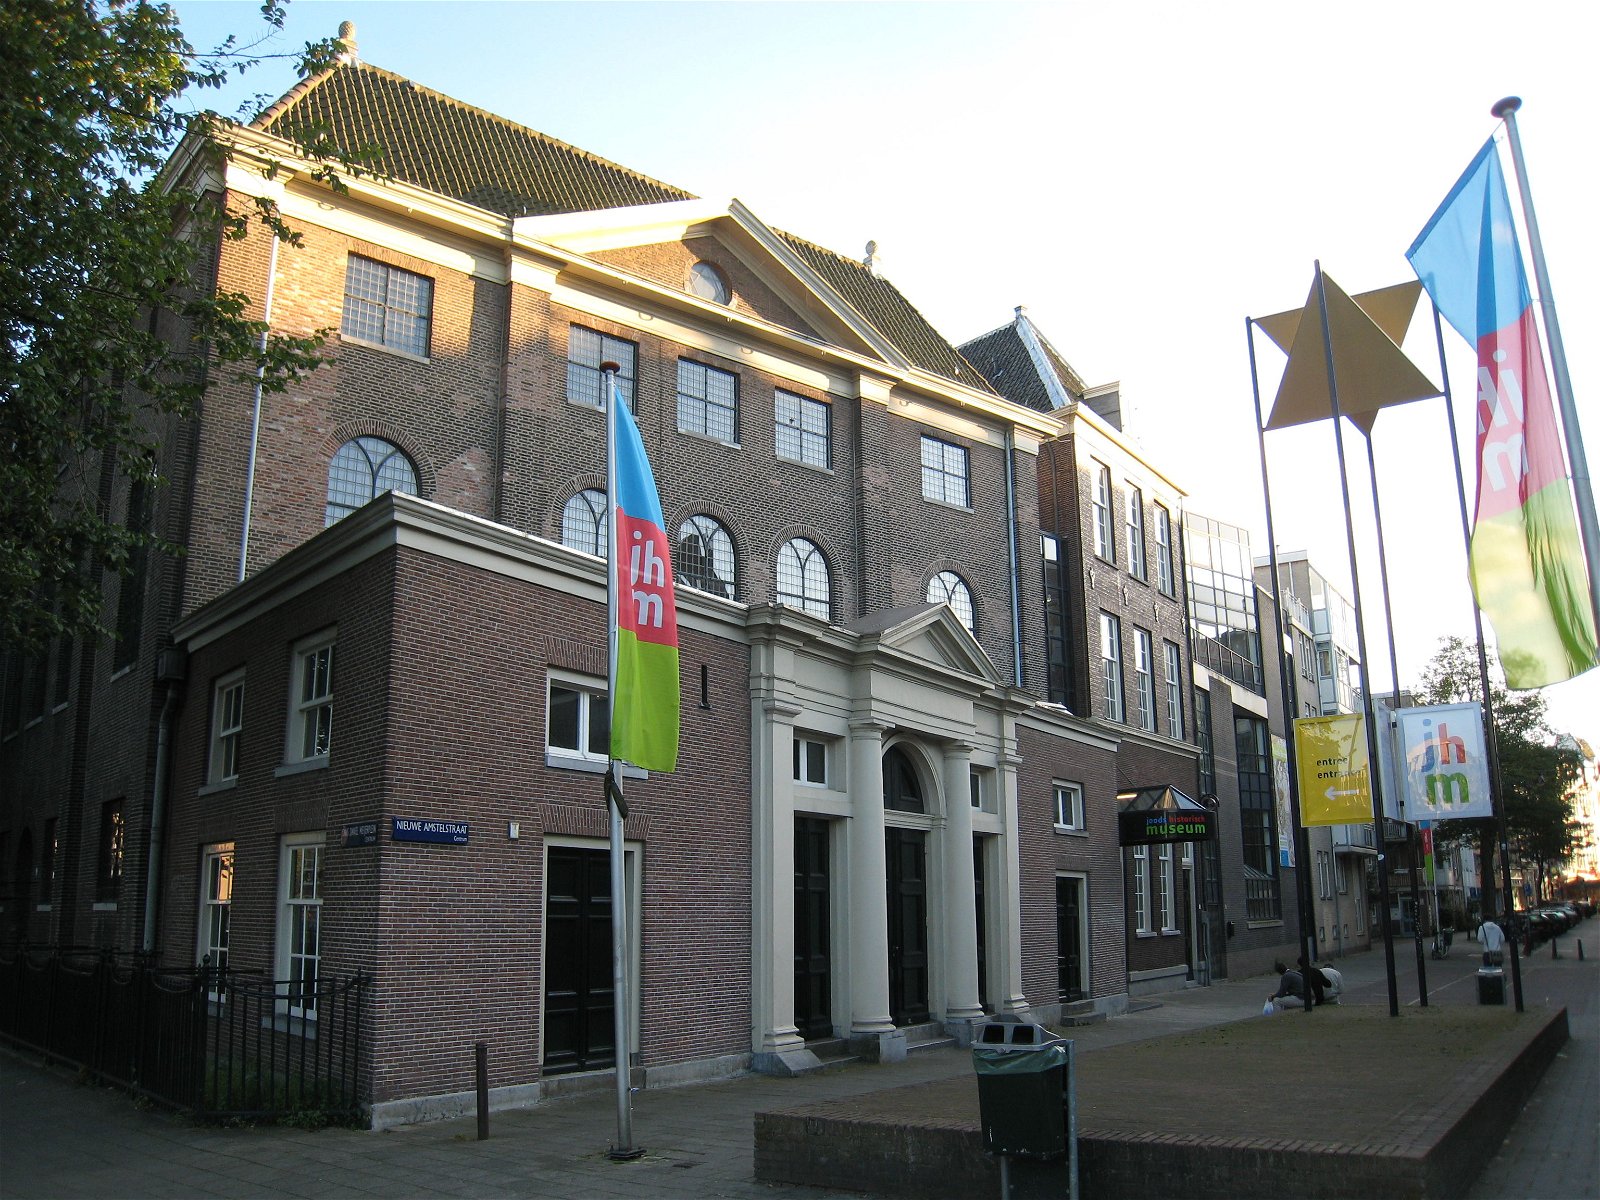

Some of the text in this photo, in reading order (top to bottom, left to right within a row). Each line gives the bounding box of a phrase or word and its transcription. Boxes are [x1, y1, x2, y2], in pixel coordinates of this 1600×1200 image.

[631, 588, 664, 628] m
[1421, 718, 1467, 772] jh
[1426, 772, 1469, 805] m
[396, 820, 468, 834] NIEUWE AMSTELSTRAAT
[1146, 824, 1206, 835] museum
